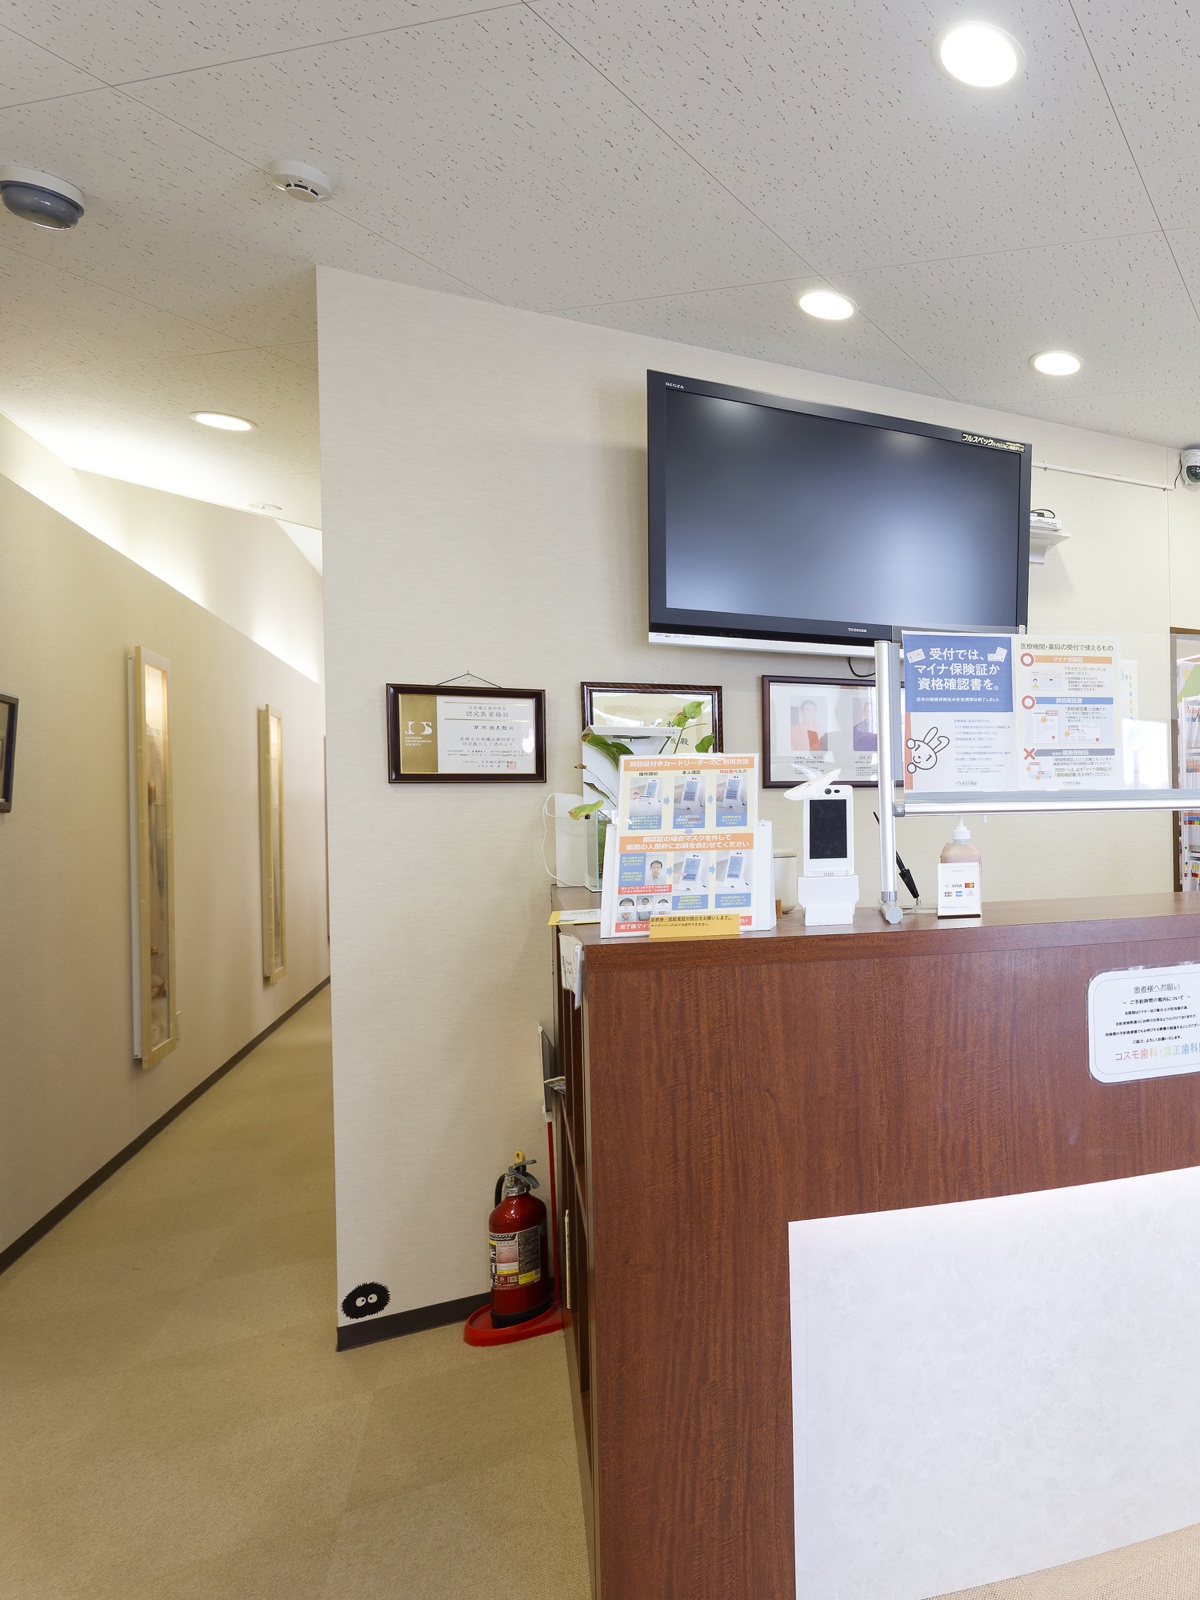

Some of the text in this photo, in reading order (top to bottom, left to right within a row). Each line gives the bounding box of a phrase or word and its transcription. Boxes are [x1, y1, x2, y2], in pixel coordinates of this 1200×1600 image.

[929, 647, 984, 661] 受付では、
[914, 662, 1000, 676] マイナ保険証か
[917, 677, 999, 691] 資格確認書を。
[1134, 983, 1180, 993] 患者様へお願い
